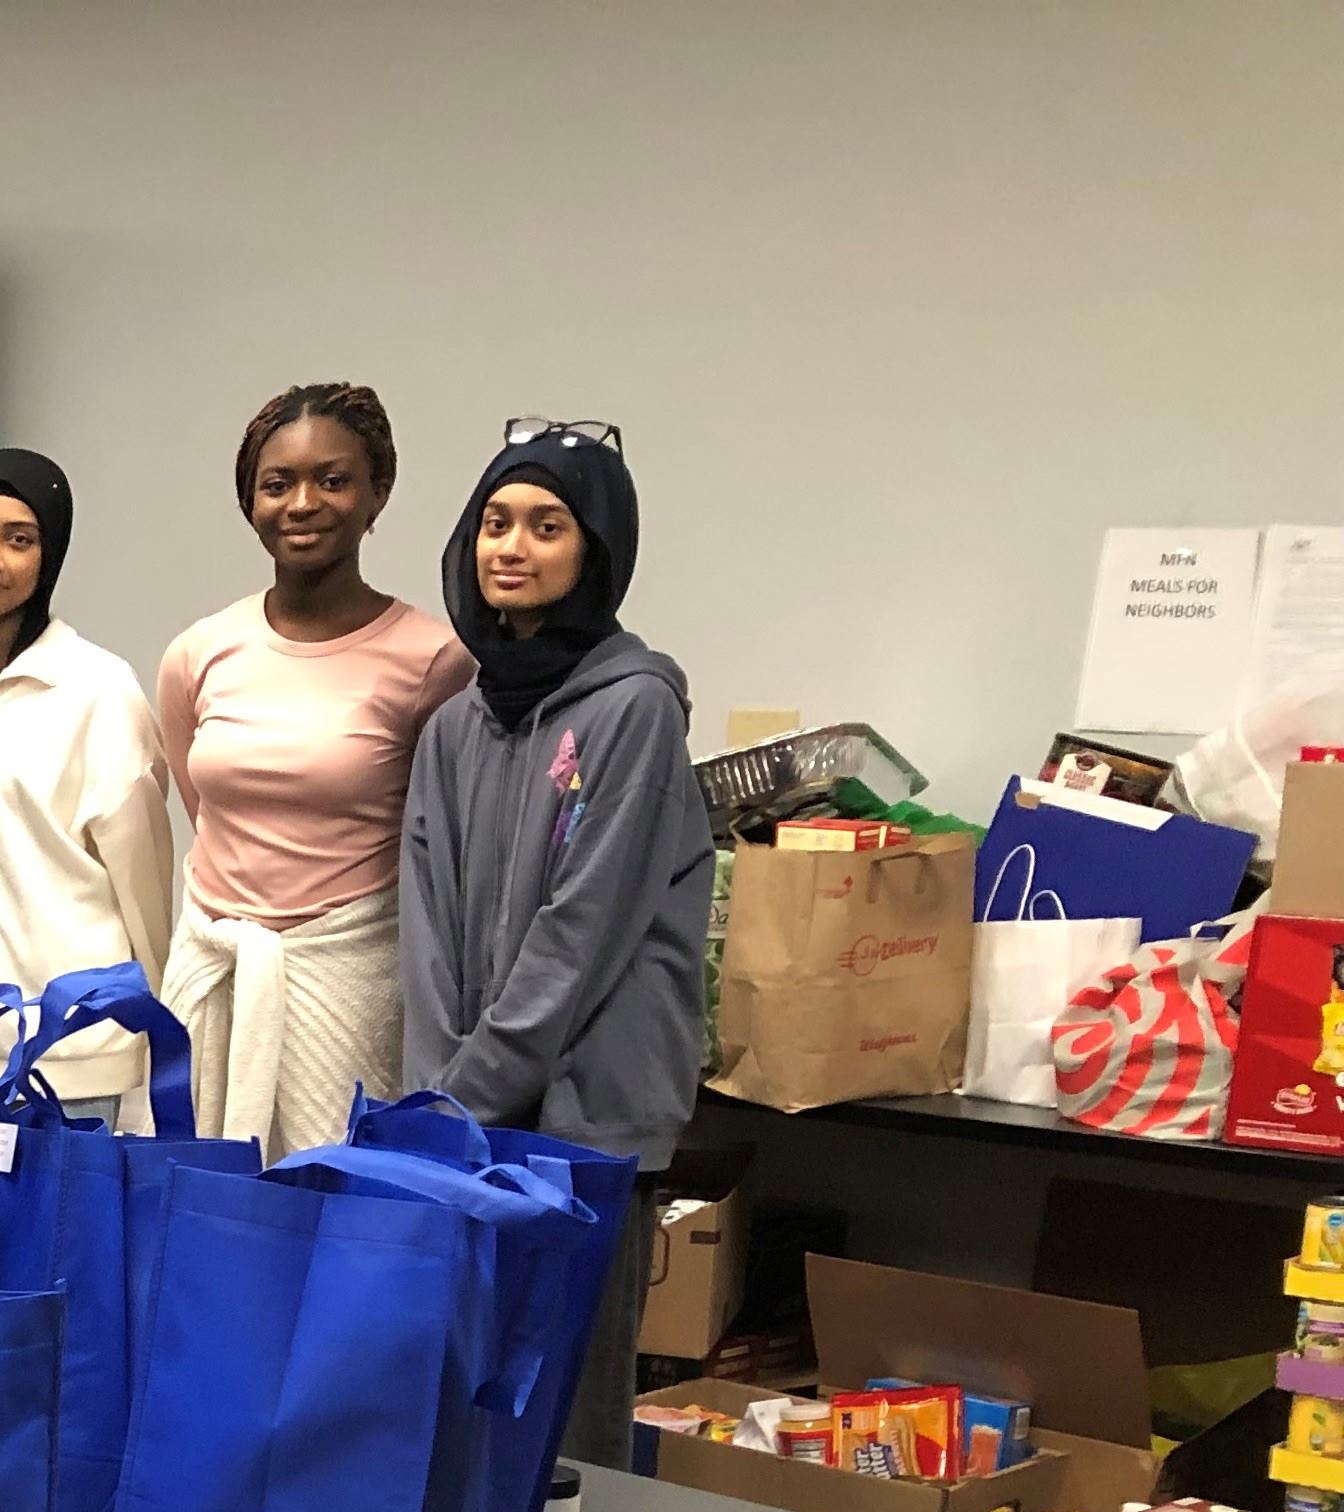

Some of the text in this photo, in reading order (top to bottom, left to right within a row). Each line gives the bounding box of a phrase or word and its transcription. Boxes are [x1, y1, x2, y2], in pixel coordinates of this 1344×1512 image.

[1130, 579, 1218, 593] MEALS FOR
[1125, 604, 1216, 618] NEIGHBORS
